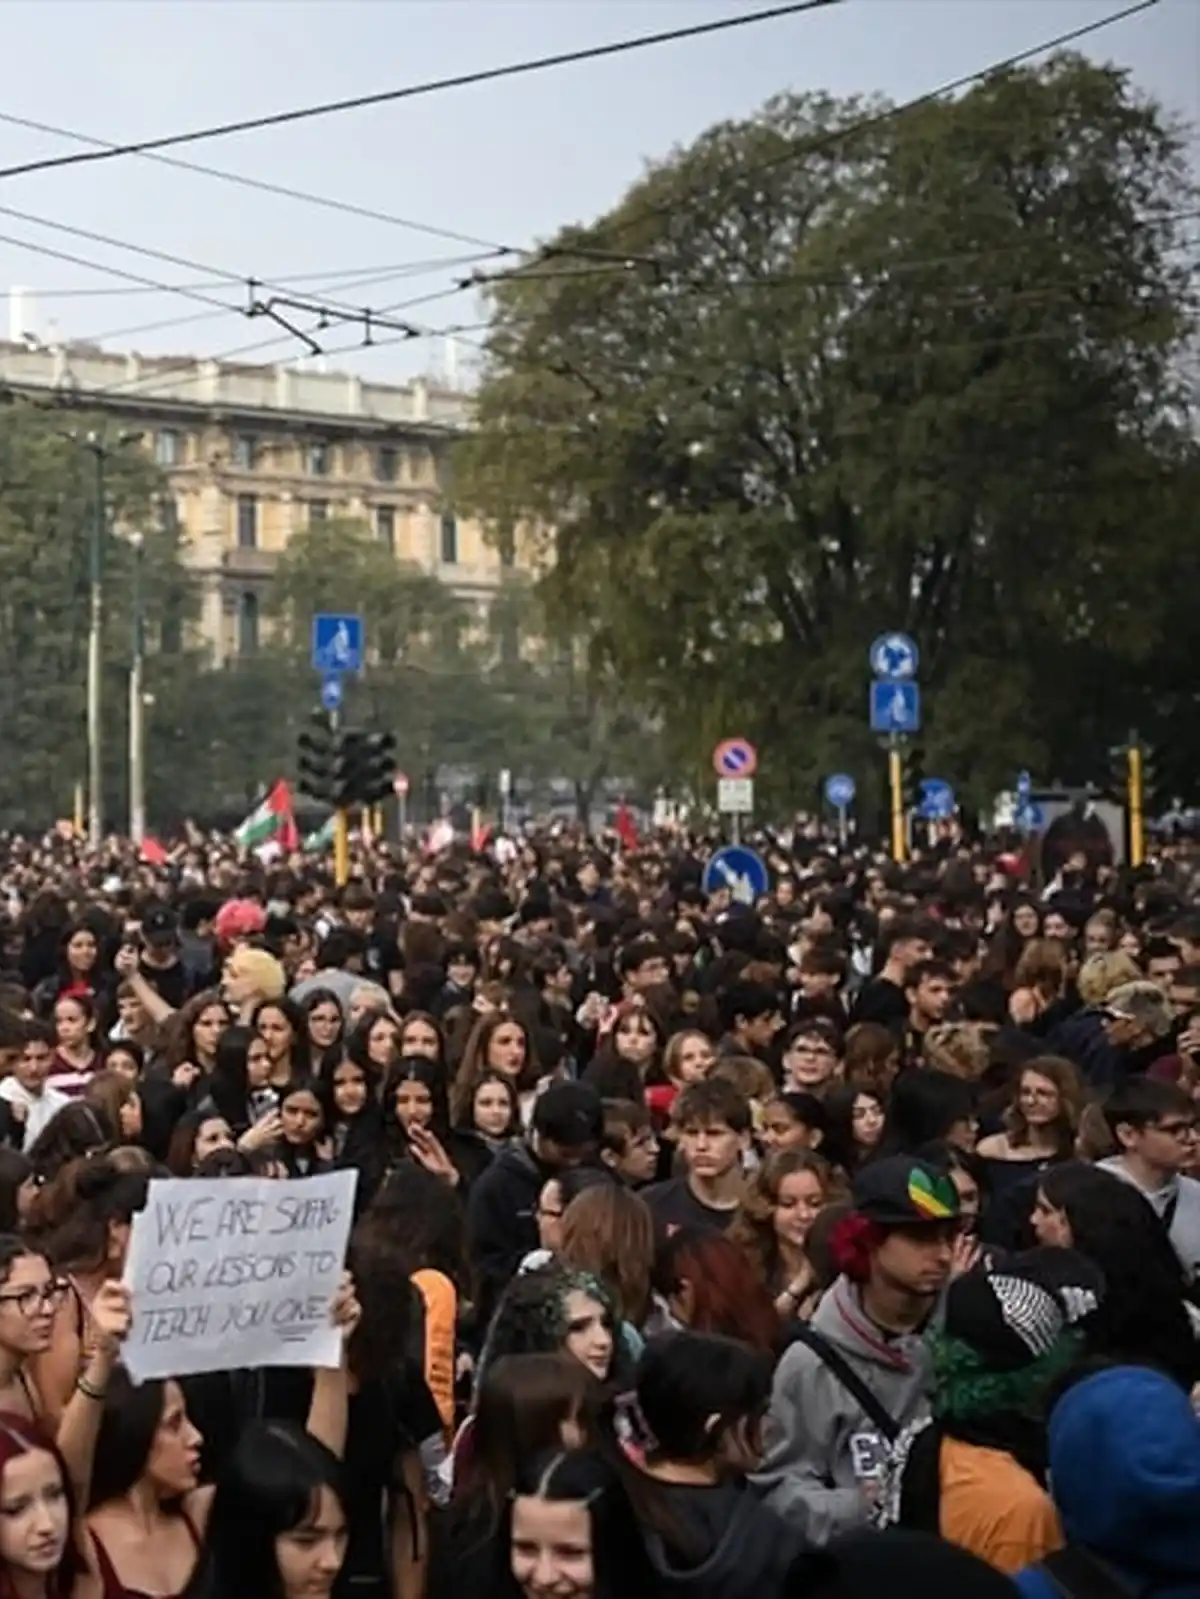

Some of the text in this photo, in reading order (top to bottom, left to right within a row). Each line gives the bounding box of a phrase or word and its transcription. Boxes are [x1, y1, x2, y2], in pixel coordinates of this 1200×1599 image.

[155, 1196, 216, 1248] WE
[215, 1198, 267, 1236] ARE
[146, 1250, 338, 1295] OUR LESSONS TO
[141, 1295, 328, 1344] TEACH YOU ONE
